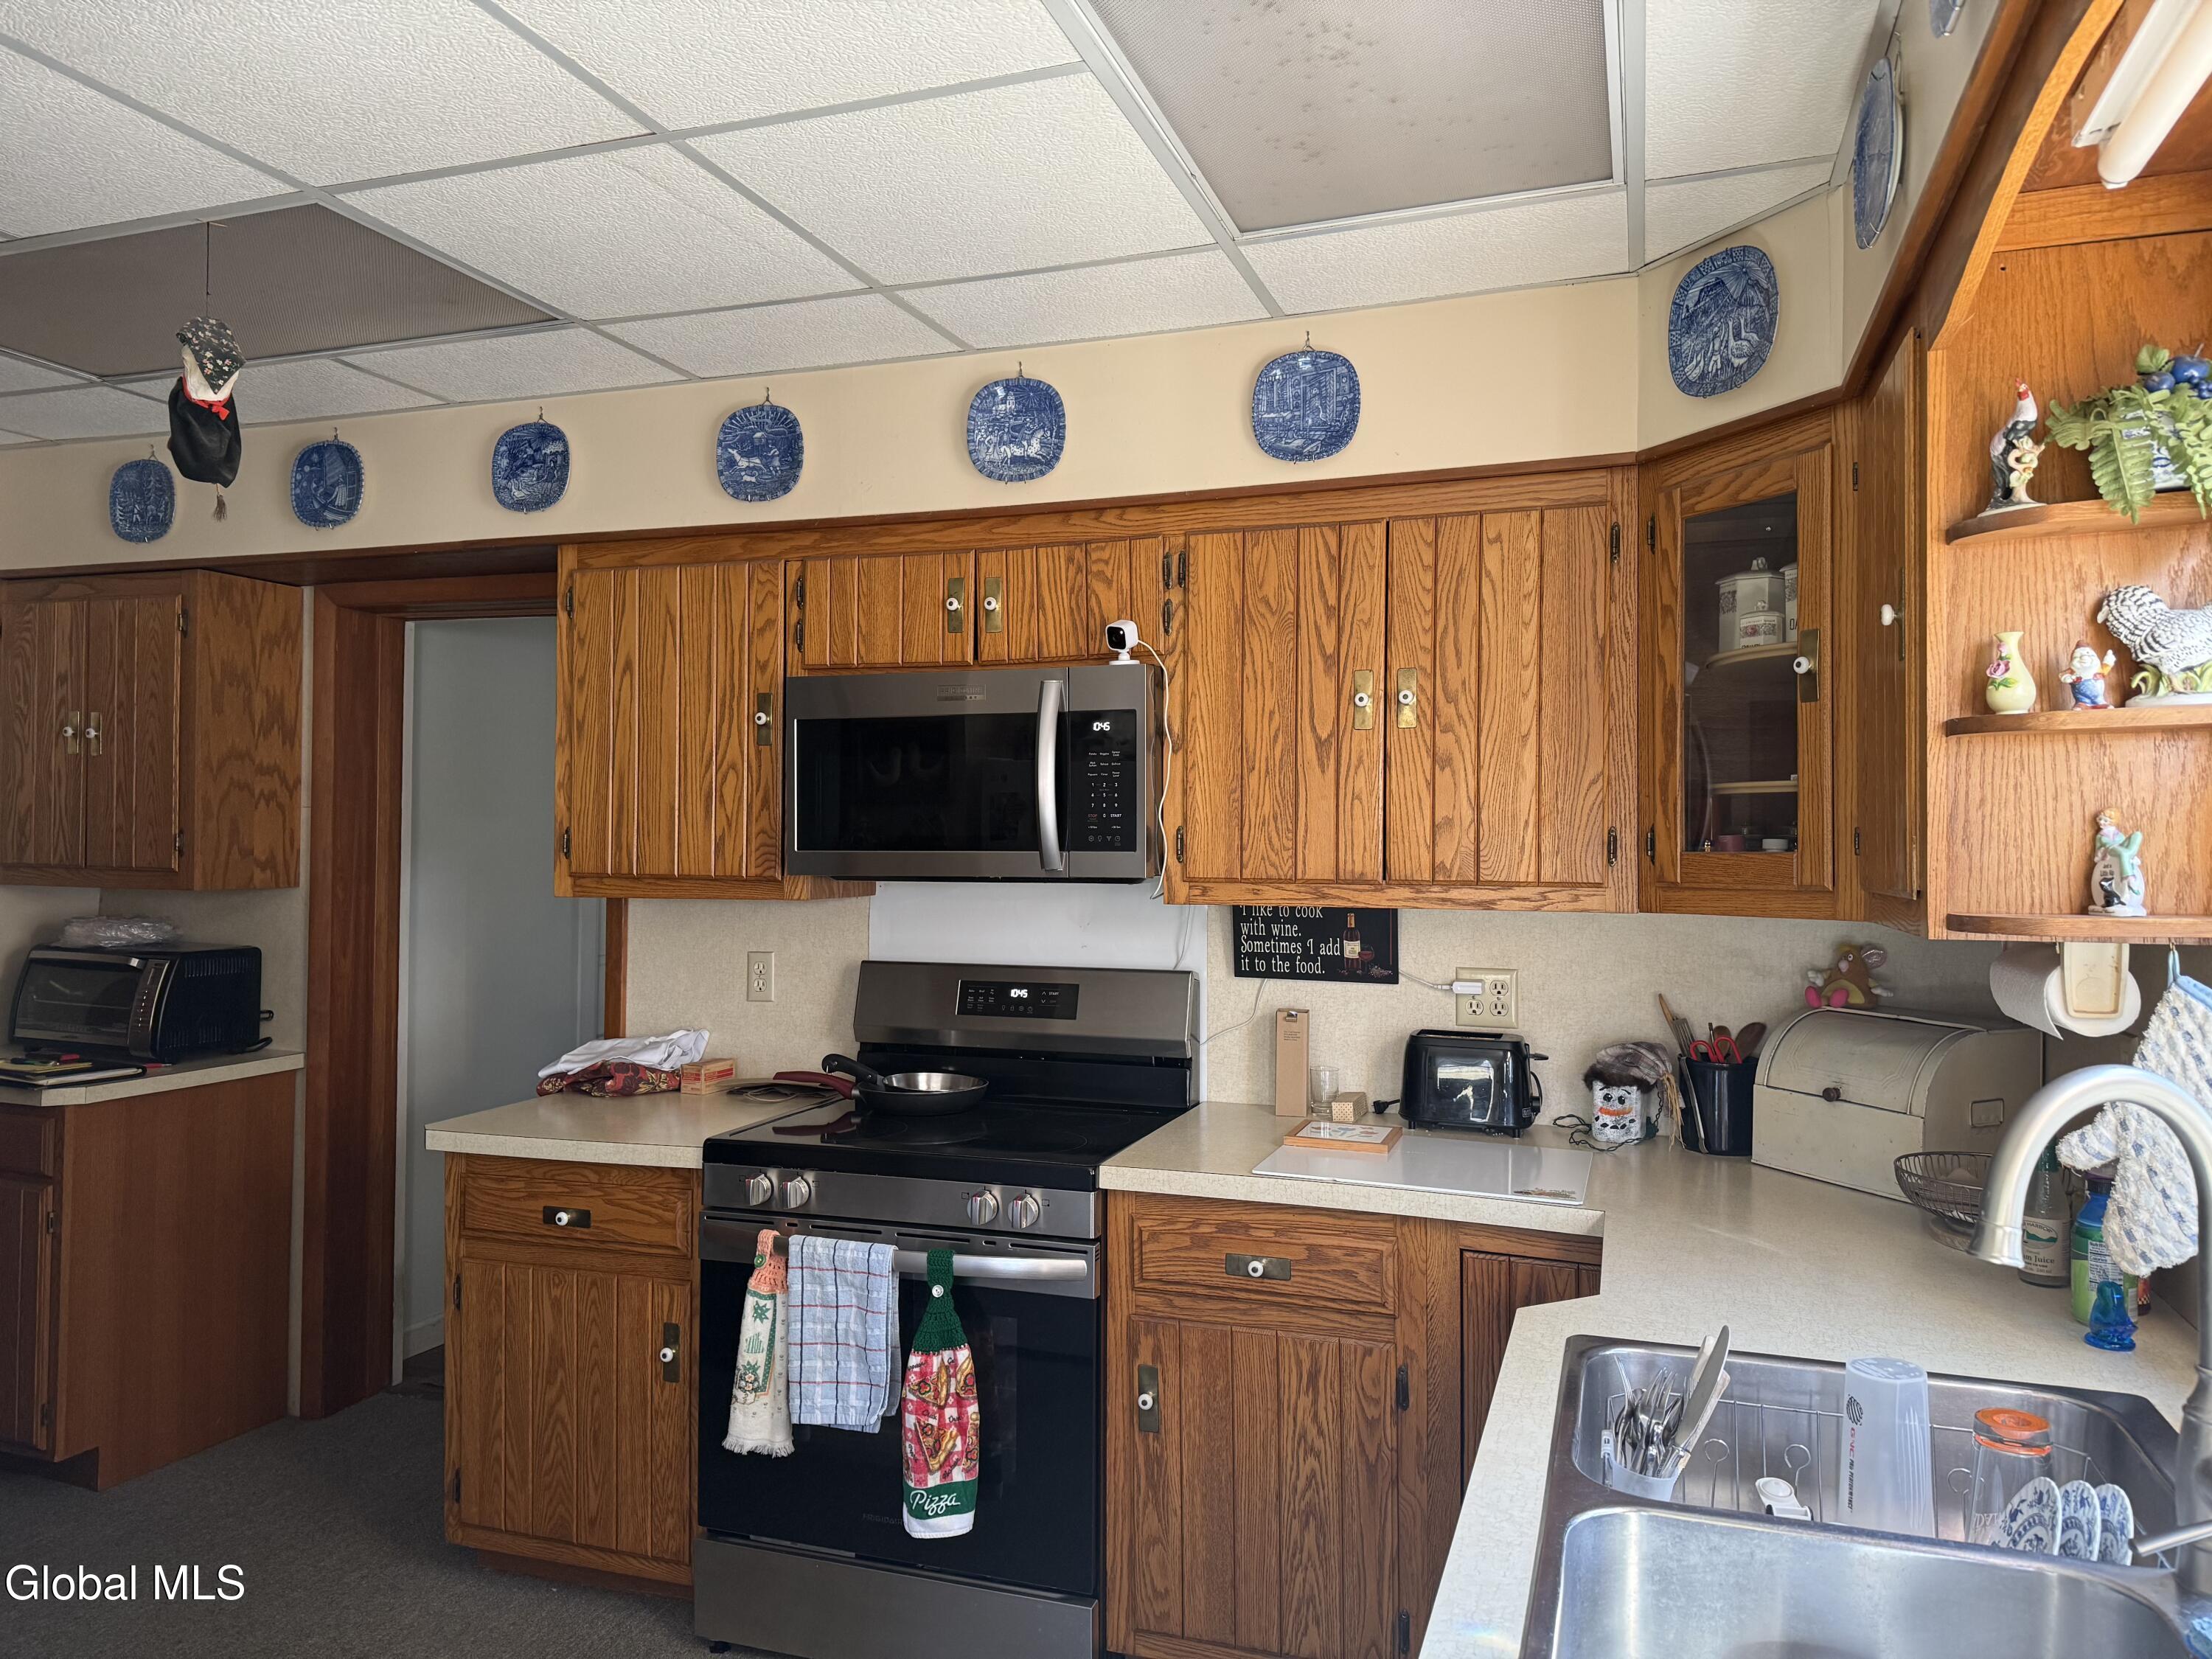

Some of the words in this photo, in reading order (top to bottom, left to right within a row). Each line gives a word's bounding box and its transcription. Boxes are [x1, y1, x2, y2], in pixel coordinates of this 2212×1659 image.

[1252, 905, 1273, 917] like
[1279, 905, 1290, 917] to
[1295, 906, 1324, 918] cook
[1240, 917, 1266, 936] with
[1270, 919, 1301, 937] wine.
[1241, 935, 1302, 954] Sometimes
[1307, 939, 1314, 955] I
[1320, 938, 1340, 956] add
[1241, 956, 1249, 971] it
[1255, 958, 1266, 972] to
[1272, 955, 1290, 973] the
[1296, 956, 1325, 974] food.
[2034, 1255, 2055, 1264] Juice
[910, 1490, 961, 1516] Pizza
[863, 1513, 902, 1526] FRIGIDAIR
